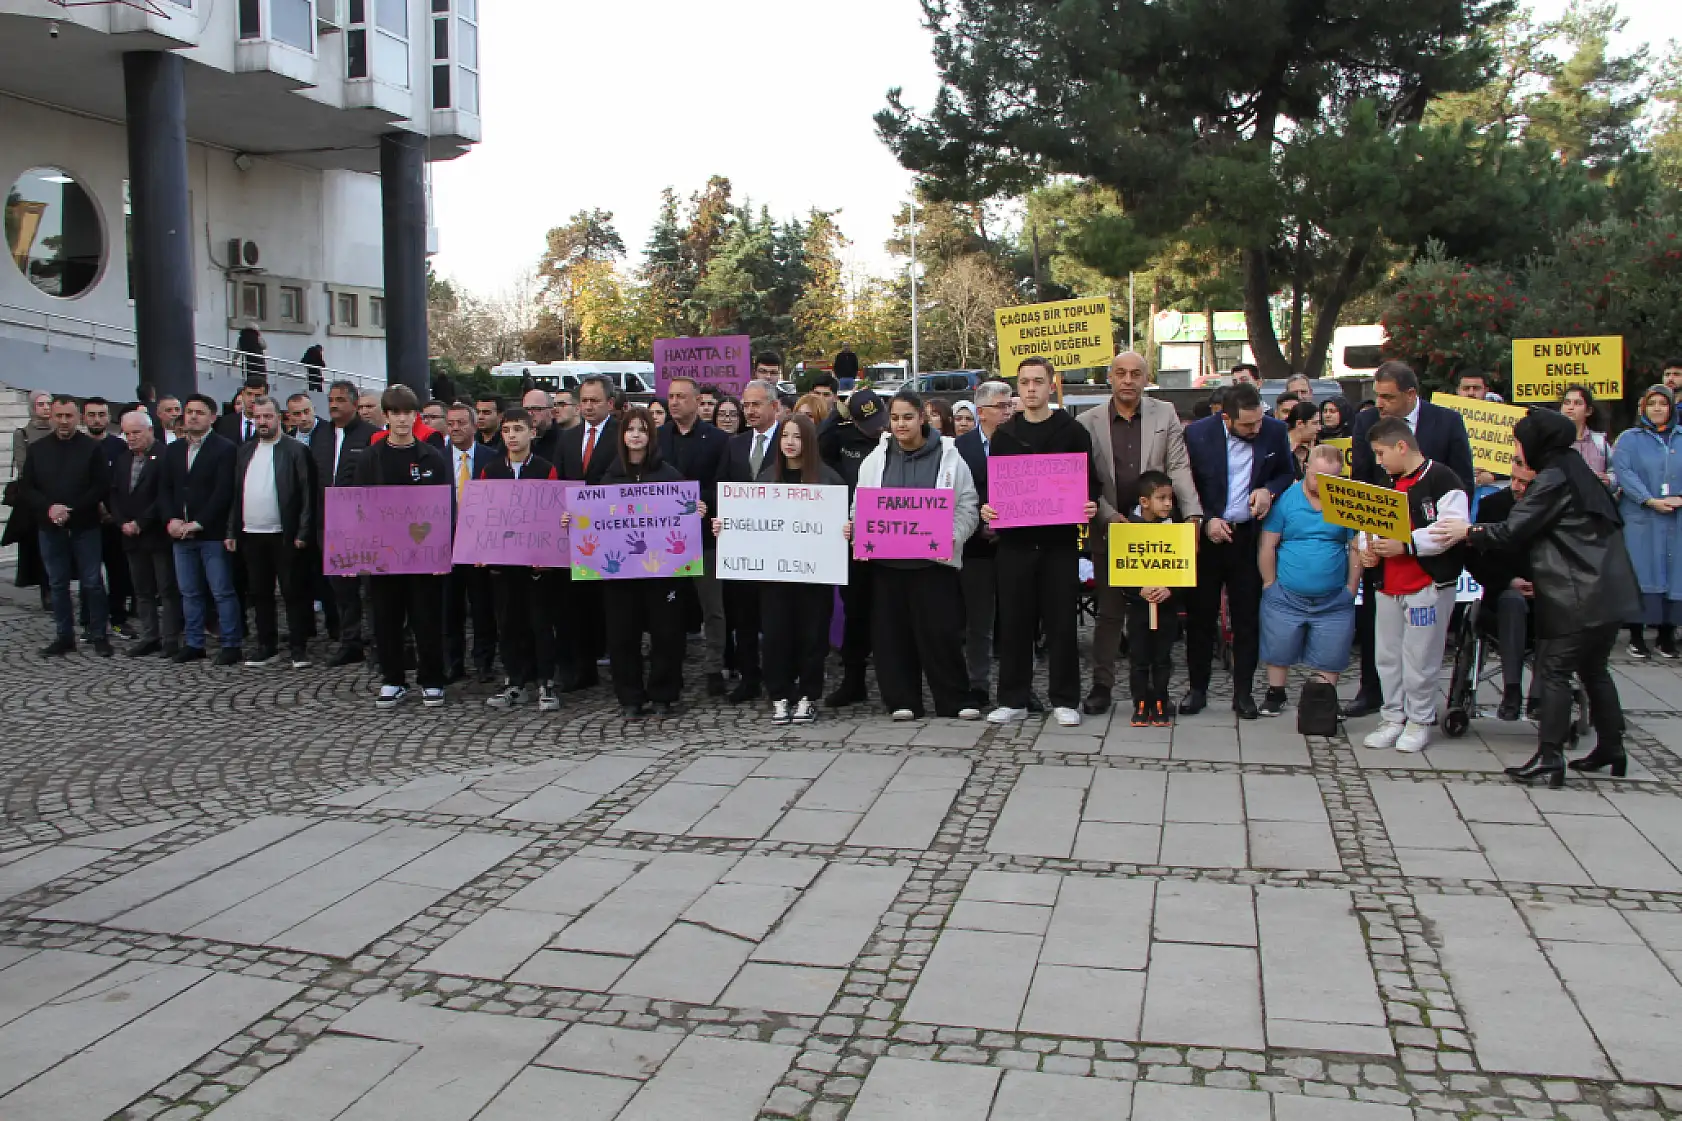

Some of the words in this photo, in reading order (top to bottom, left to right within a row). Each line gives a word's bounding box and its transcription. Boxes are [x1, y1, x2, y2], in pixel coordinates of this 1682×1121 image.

[1043, 307, 1061, 320] BİR
[1063, 303, 1106, 318] TOPLUM
[1020, 321, 1088, 339] ENGELLİLERE
[664, 347, 721, 361] HAYATTA
[725, 345, 741, 359] EN
[1533, 344, 1551, 357] EN
[1555, 340, 1601, 356] BÜYÜK
[703, 364, 739, 378] ENGEL
[1546, 362, 1589, 376] ENGEL
[465, 483, 494, 507] EN
[577, 489, 606, 501] AYNI
[772, 488, 780, 499] 3
[1326, 483, 1400, 508] ENGELSİZ
[877, 496, 949, 510] FARKLIYIZ
[484, 507, 548, 527] ENGEL
[723, 556, 764, 571] KUTLU
[777, 559, 817, 574] OLSUN
[1116, 556, 1139, 569] BİZ
[1140, 558, 1189, 570] VARIZ!
[1409, 607, 1436, 626] NBA
